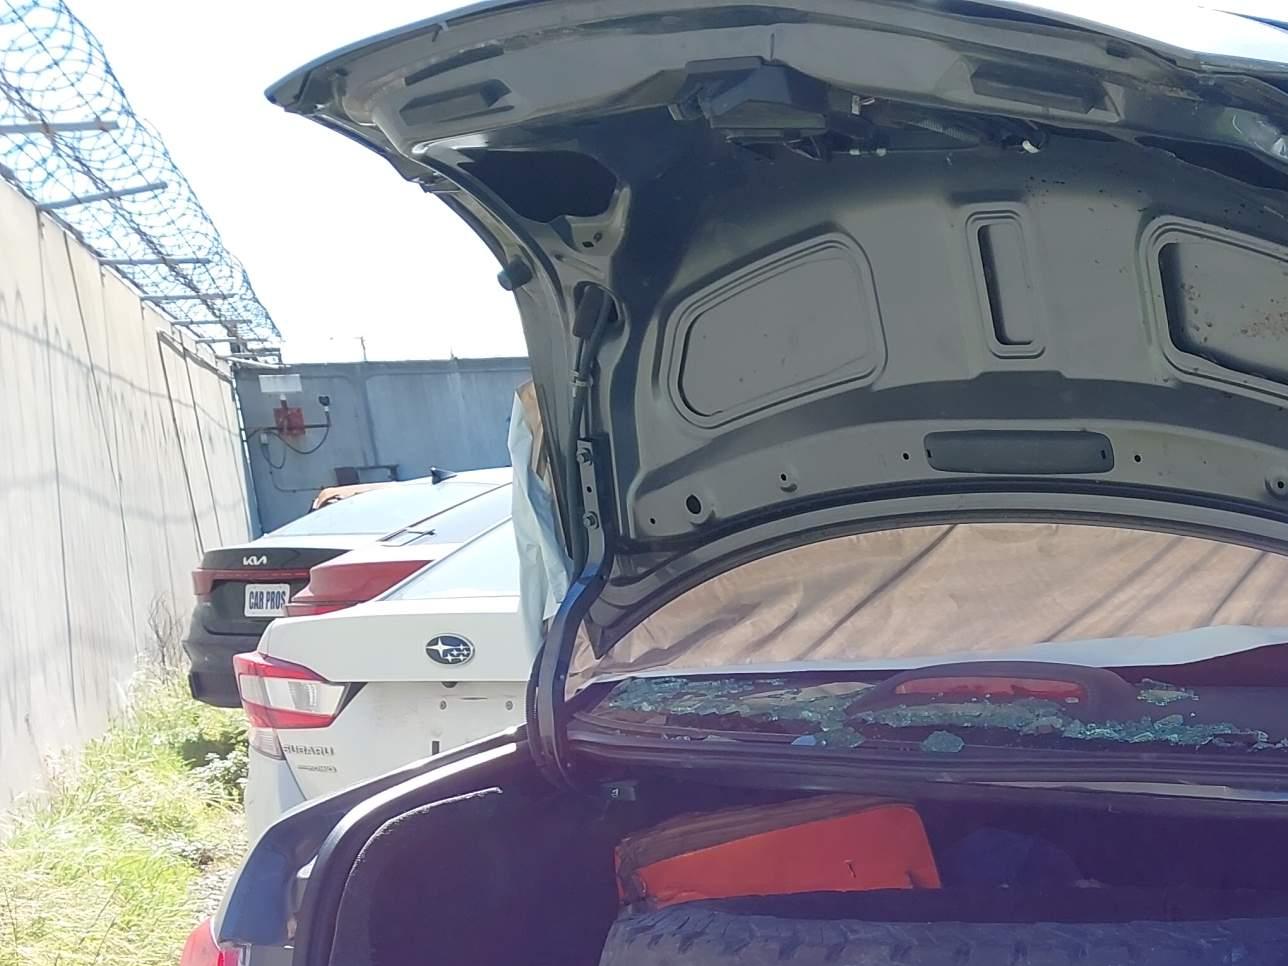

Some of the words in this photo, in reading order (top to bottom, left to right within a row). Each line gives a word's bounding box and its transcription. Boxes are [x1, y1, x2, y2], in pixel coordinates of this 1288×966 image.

[243, 555, 267, 566] KIA
[249, 591, 264, 610] CAR
[265, 590, 286, 610] PROS
